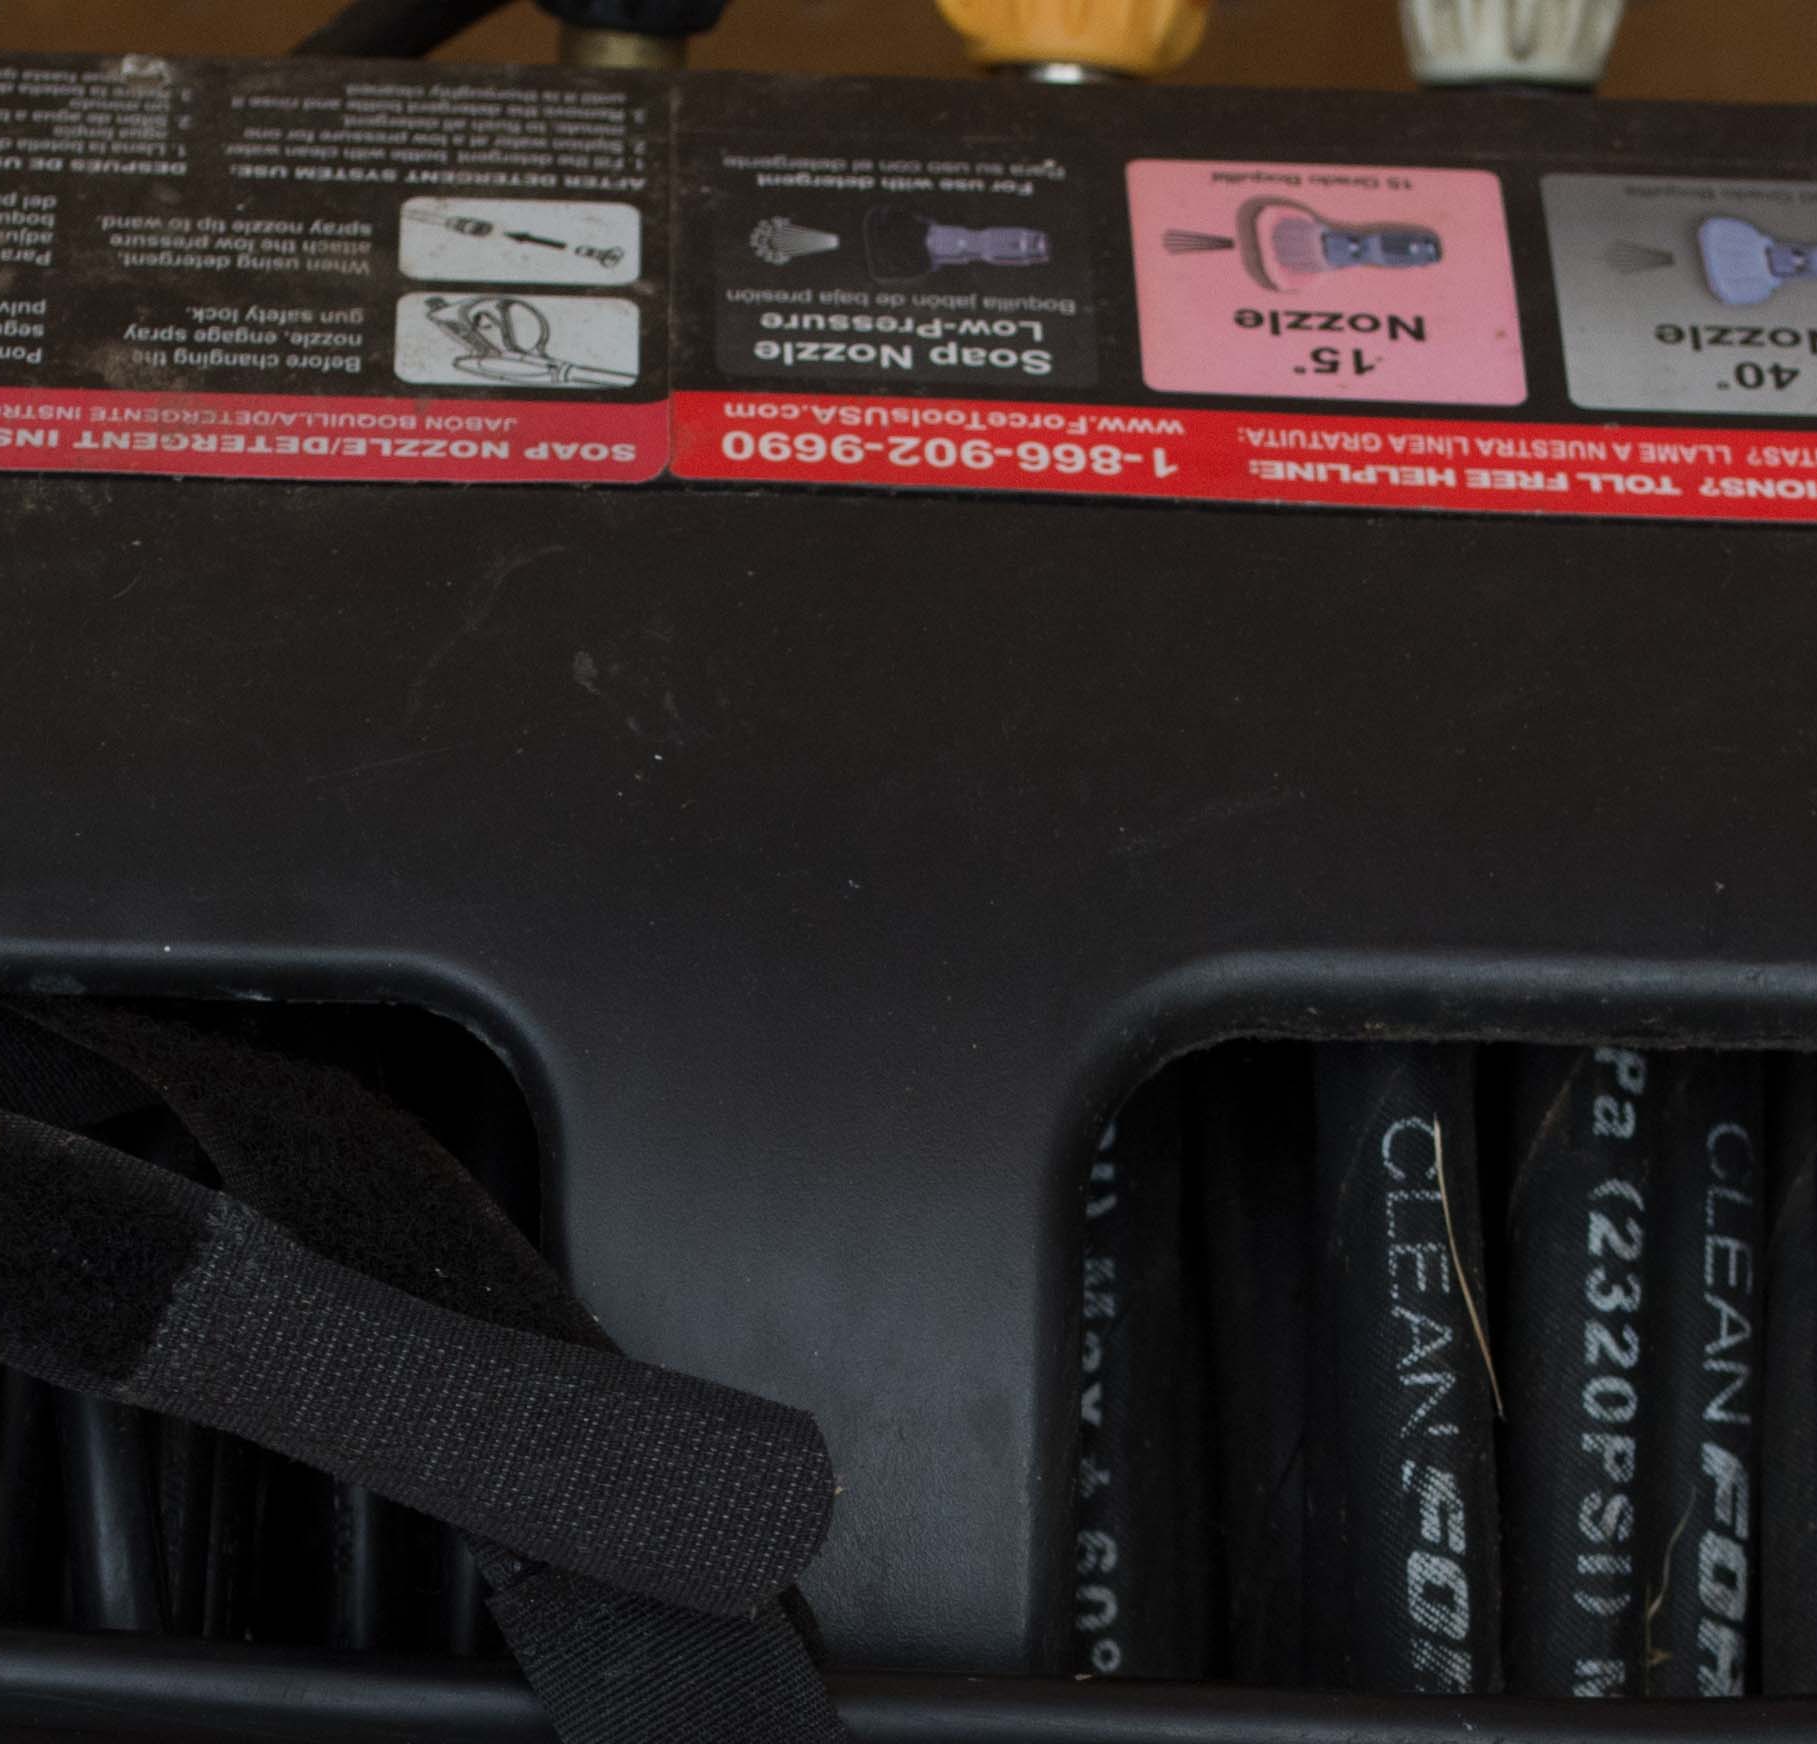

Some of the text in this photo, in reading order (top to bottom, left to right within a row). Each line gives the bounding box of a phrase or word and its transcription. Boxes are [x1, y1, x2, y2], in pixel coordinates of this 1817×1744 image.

[30, 157, 63, 171] DE
[231, 164, 646, 190] AFTER DETERGENT SYSTEM USE:
[757, 172, 1034, 196] For use with detergent
[22, 195, 57, 211] del
[99, 215, 372, 236] spray nozzle tip to wand.
[109, 231, 371, 256] attach the low pressure
[0, 248, 52, 266] Para
[236, 250, 300, 270] using
[306, 258, 371, 275] When
[726, 289, 1076, 315] Boquilla jabón de baja presión
[186, 305, 364, 326] gun safety lock.
[761, 313, 1043, 340] Low-Pressure
[1234, 309, 1425, 341] Nozzle
[124, 323, 187, 342] spray
[194, 325, 278, 344] engage
[131, 348, 361, 373] Before changing the
[755, 341, 1051, 375] Soap Nozzle
[1294, 347, 1374, 376] 15°
[1719, 362, 1799, 390] 40°
[91, 407, 417, 429] BOQUILLA/DETERGENTE
[424, 415, 517, 432] JABÓN
[725, 403, 1183, 435] www.ForceToolsUSA.com
[76, 430, 509, 458] NOZZLE/DETERGENT
[524, 441, 636, 462] SOAP
[1239, 428, 1382, 452] GRATUITA:
[1388, 434, 1470, 457] LÍNEA
[1476, 437, 1607, 460] NUESTRA
[1612, 441, 1632, 462] A
[723, 431, 1174, 476] 1-866-902-9690
[1639, 441, 1732, 464] LLAME
[1250, 460, 1456, 486] HELPLINE:
[1466, 469, 1569, 491] FREE
[1577, 472, 1680, 496] TOLL
[1381, 1115, 1459, 1440] CLEAN
[1699, 1121, 1754, 1425] CLEAN
[1572, 1178, 1645, 1616] (2320PSI)
